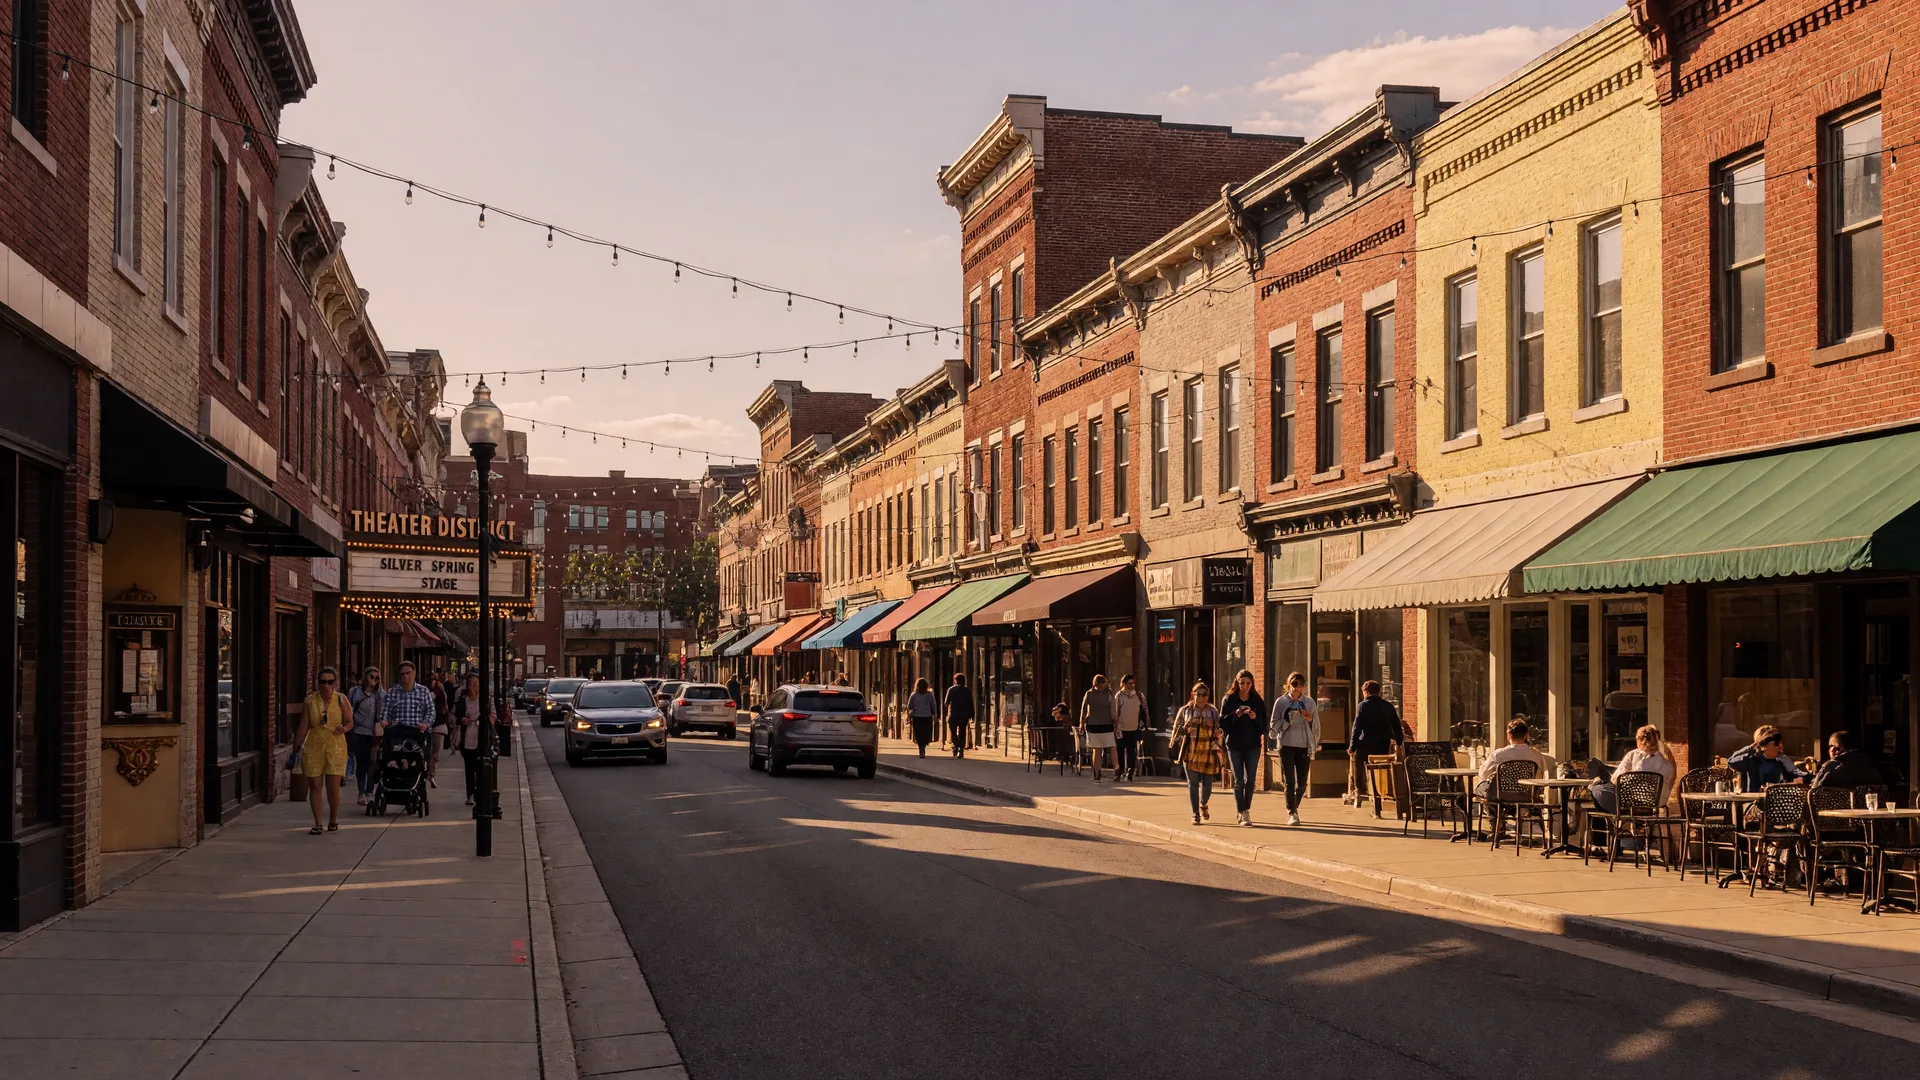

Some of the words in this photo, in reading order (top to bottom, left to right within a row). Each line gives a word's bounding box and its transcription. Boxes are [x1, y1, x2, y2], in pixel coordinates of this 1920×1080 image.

[351, 510, 432, 536] THEATER
[438, 516, 516, 541] DISTICT
[380, 557, 422, 571] SILVER
[431, 560, 475, 573] SPRING
[421, 577, 458, 590] STAGE
